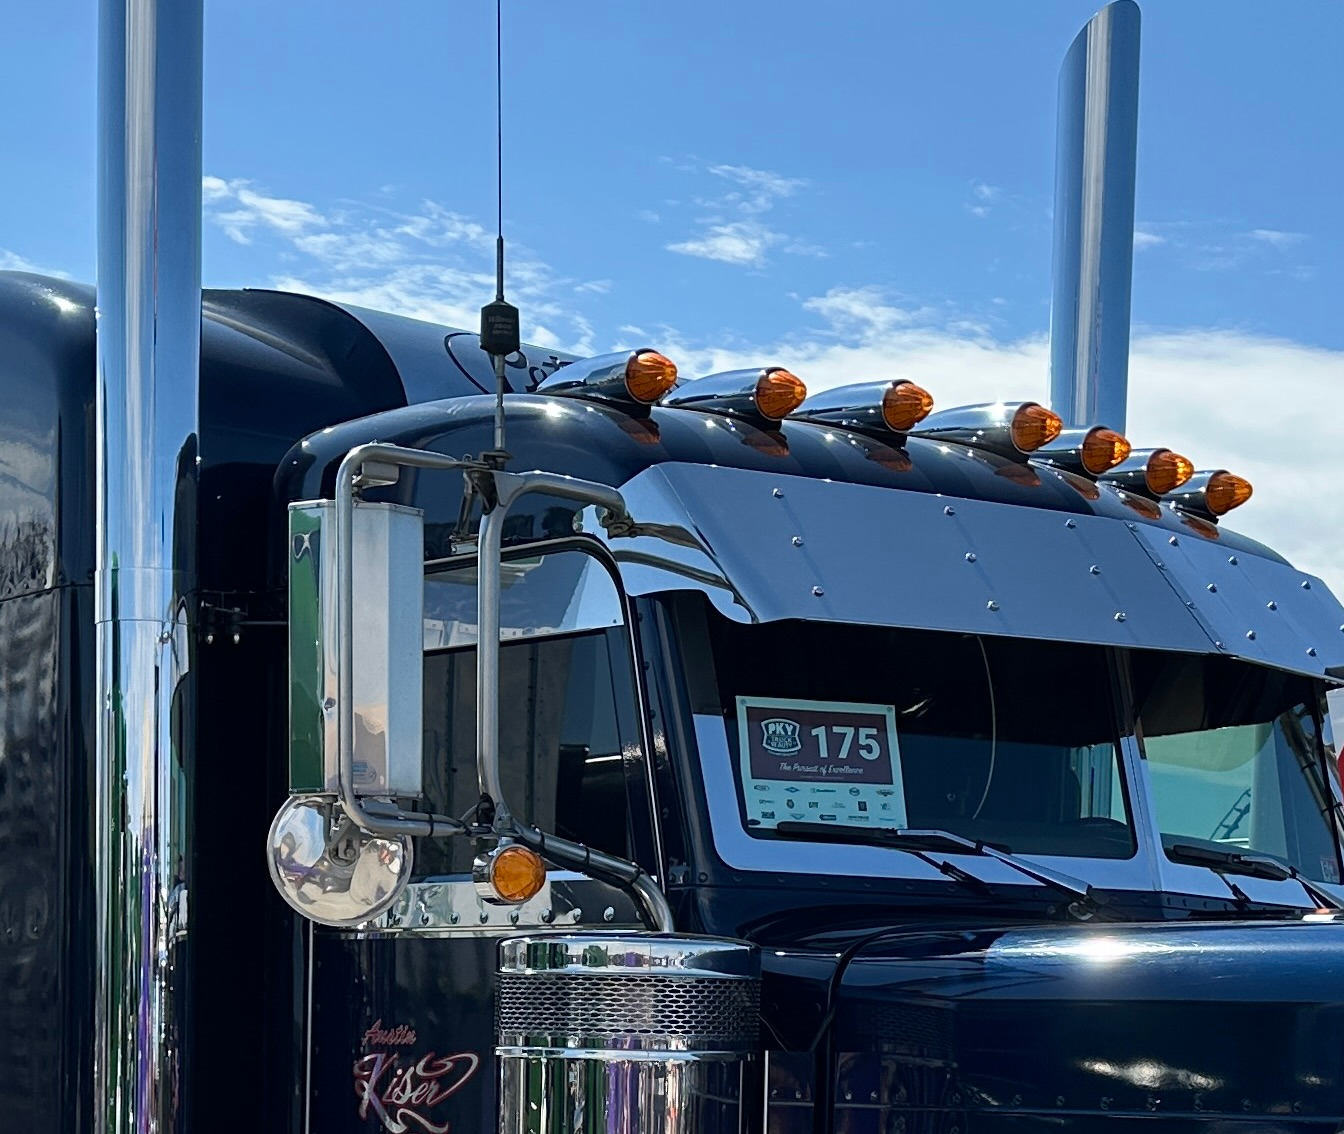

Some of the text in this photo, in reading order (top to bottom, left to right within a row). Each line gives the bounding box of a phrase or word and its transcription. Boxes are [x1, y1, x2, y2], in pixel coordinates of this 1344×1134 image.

[768, 722, 794, 736] PKY
[810, 725, 881, 761] 175
[779, 762, 791, 771] The
[819, 765, 828, 776] of
[362, 1018, 417, 1046] Austin
[353, 1051, 479, 1134] Kiser
